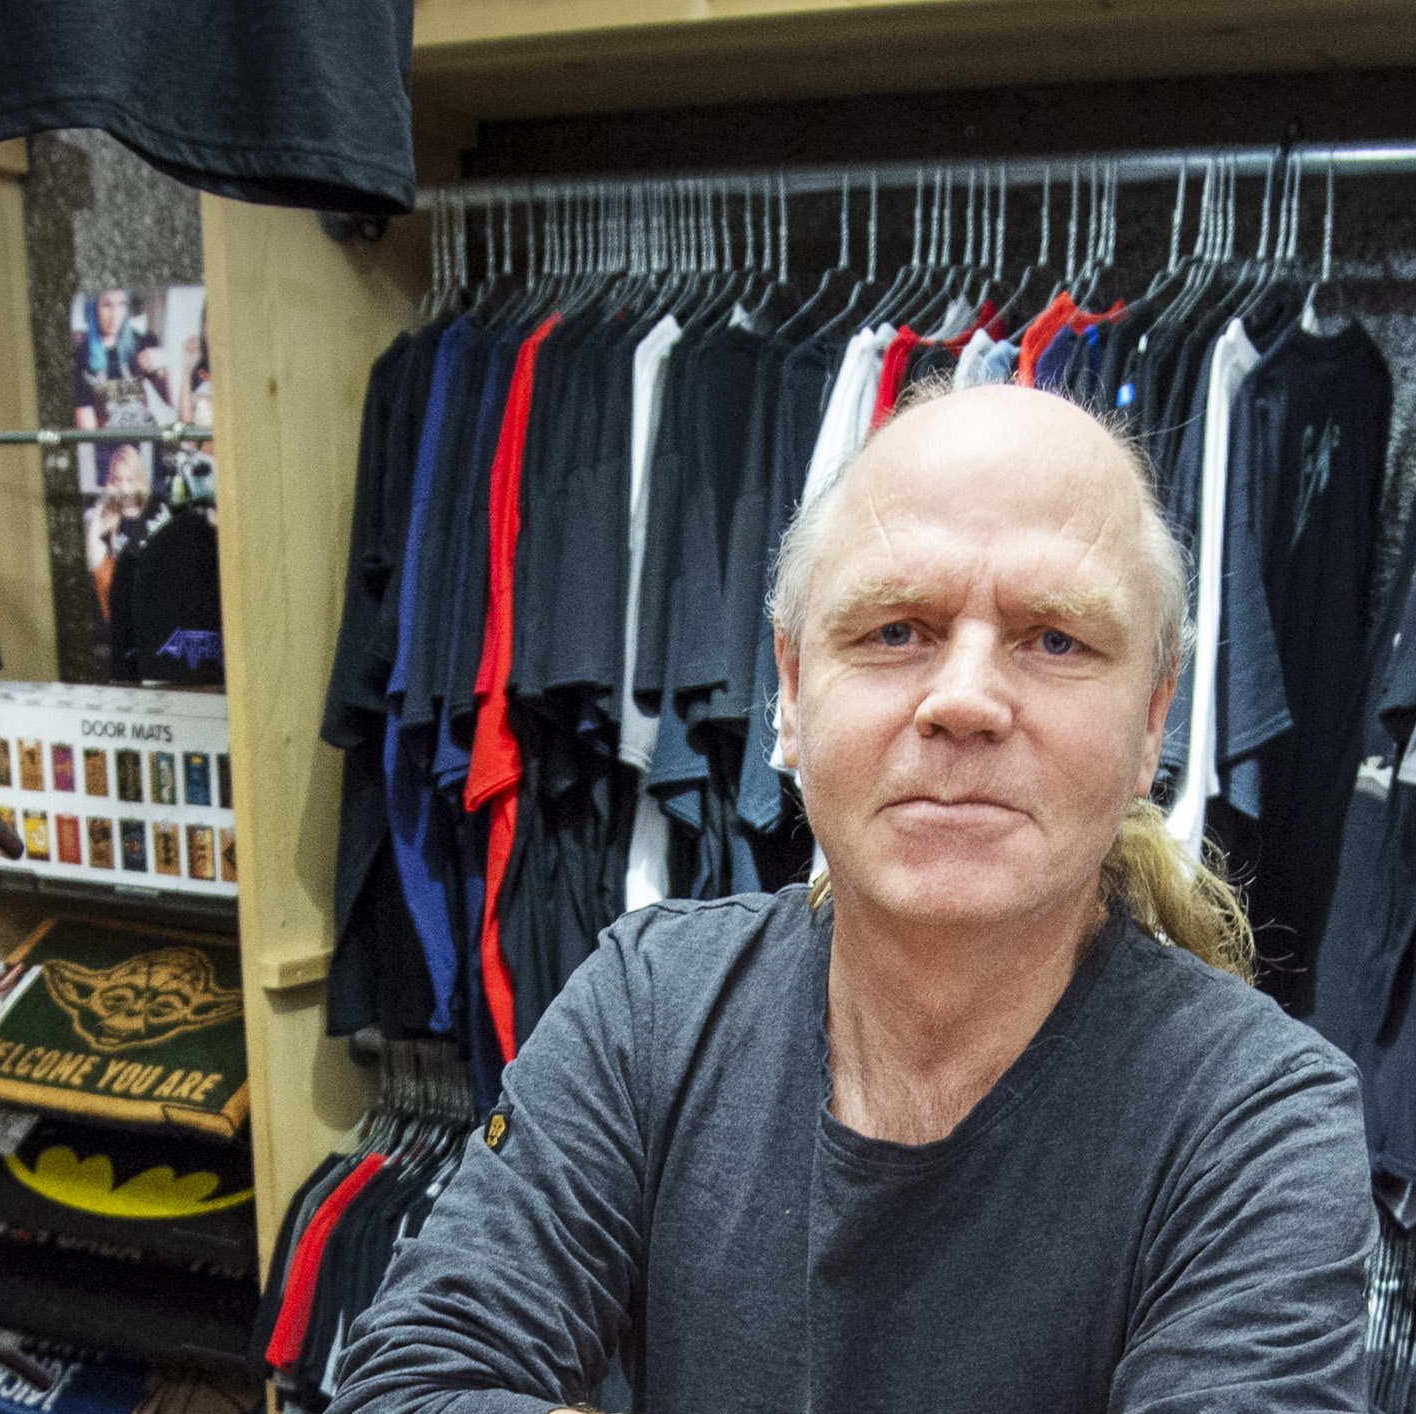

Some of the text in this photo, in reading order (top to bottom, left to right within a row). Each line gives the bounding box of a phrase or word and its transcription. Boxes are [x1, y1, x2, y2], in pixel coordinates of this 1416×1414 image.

[81, 720, 174, 742] DOOR MATS
[96, 1059, 164, 1096] YOU
[153, 1069, 224, 1101] ARE
